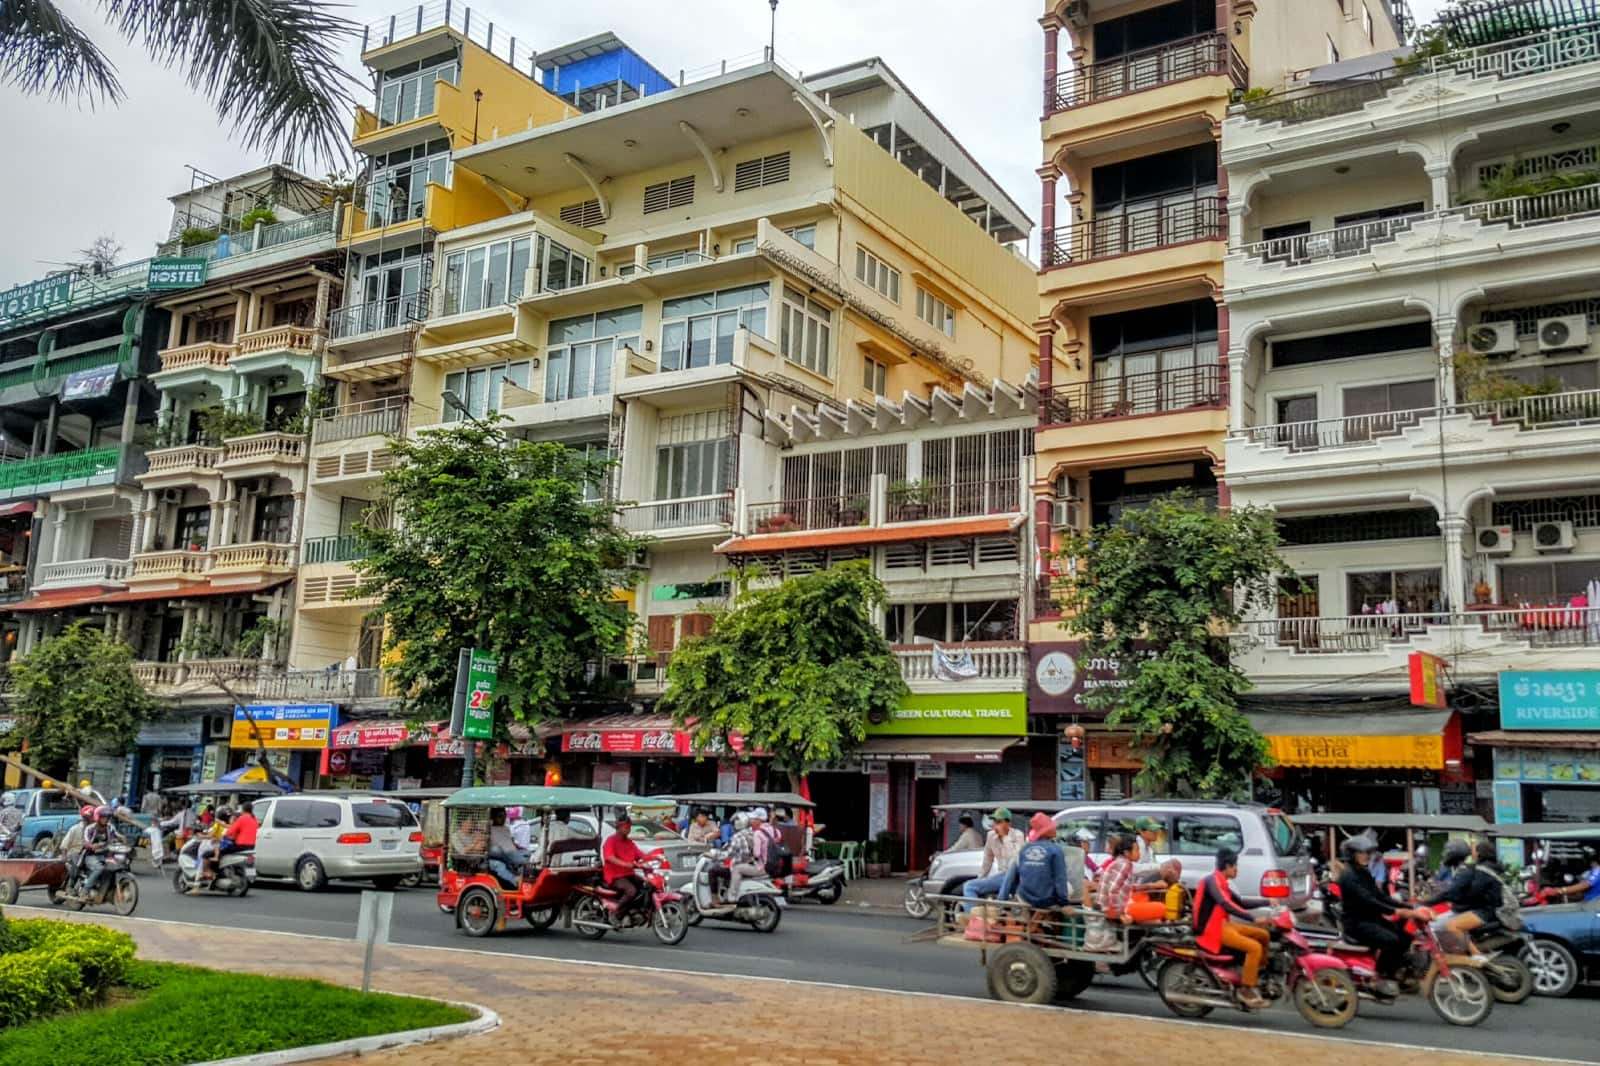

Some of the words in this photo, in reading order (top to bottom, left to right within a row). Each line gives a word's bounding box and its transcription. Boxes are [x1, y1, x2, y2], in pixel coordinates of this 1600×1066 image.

[150, 271, 201, 282] HOSTEL
[924, 709, 972, 718] CULTURAL
[975, 709, 1012, 718] TRAVEL
[1516, 706, 1598, 720] RIVERSIDE
